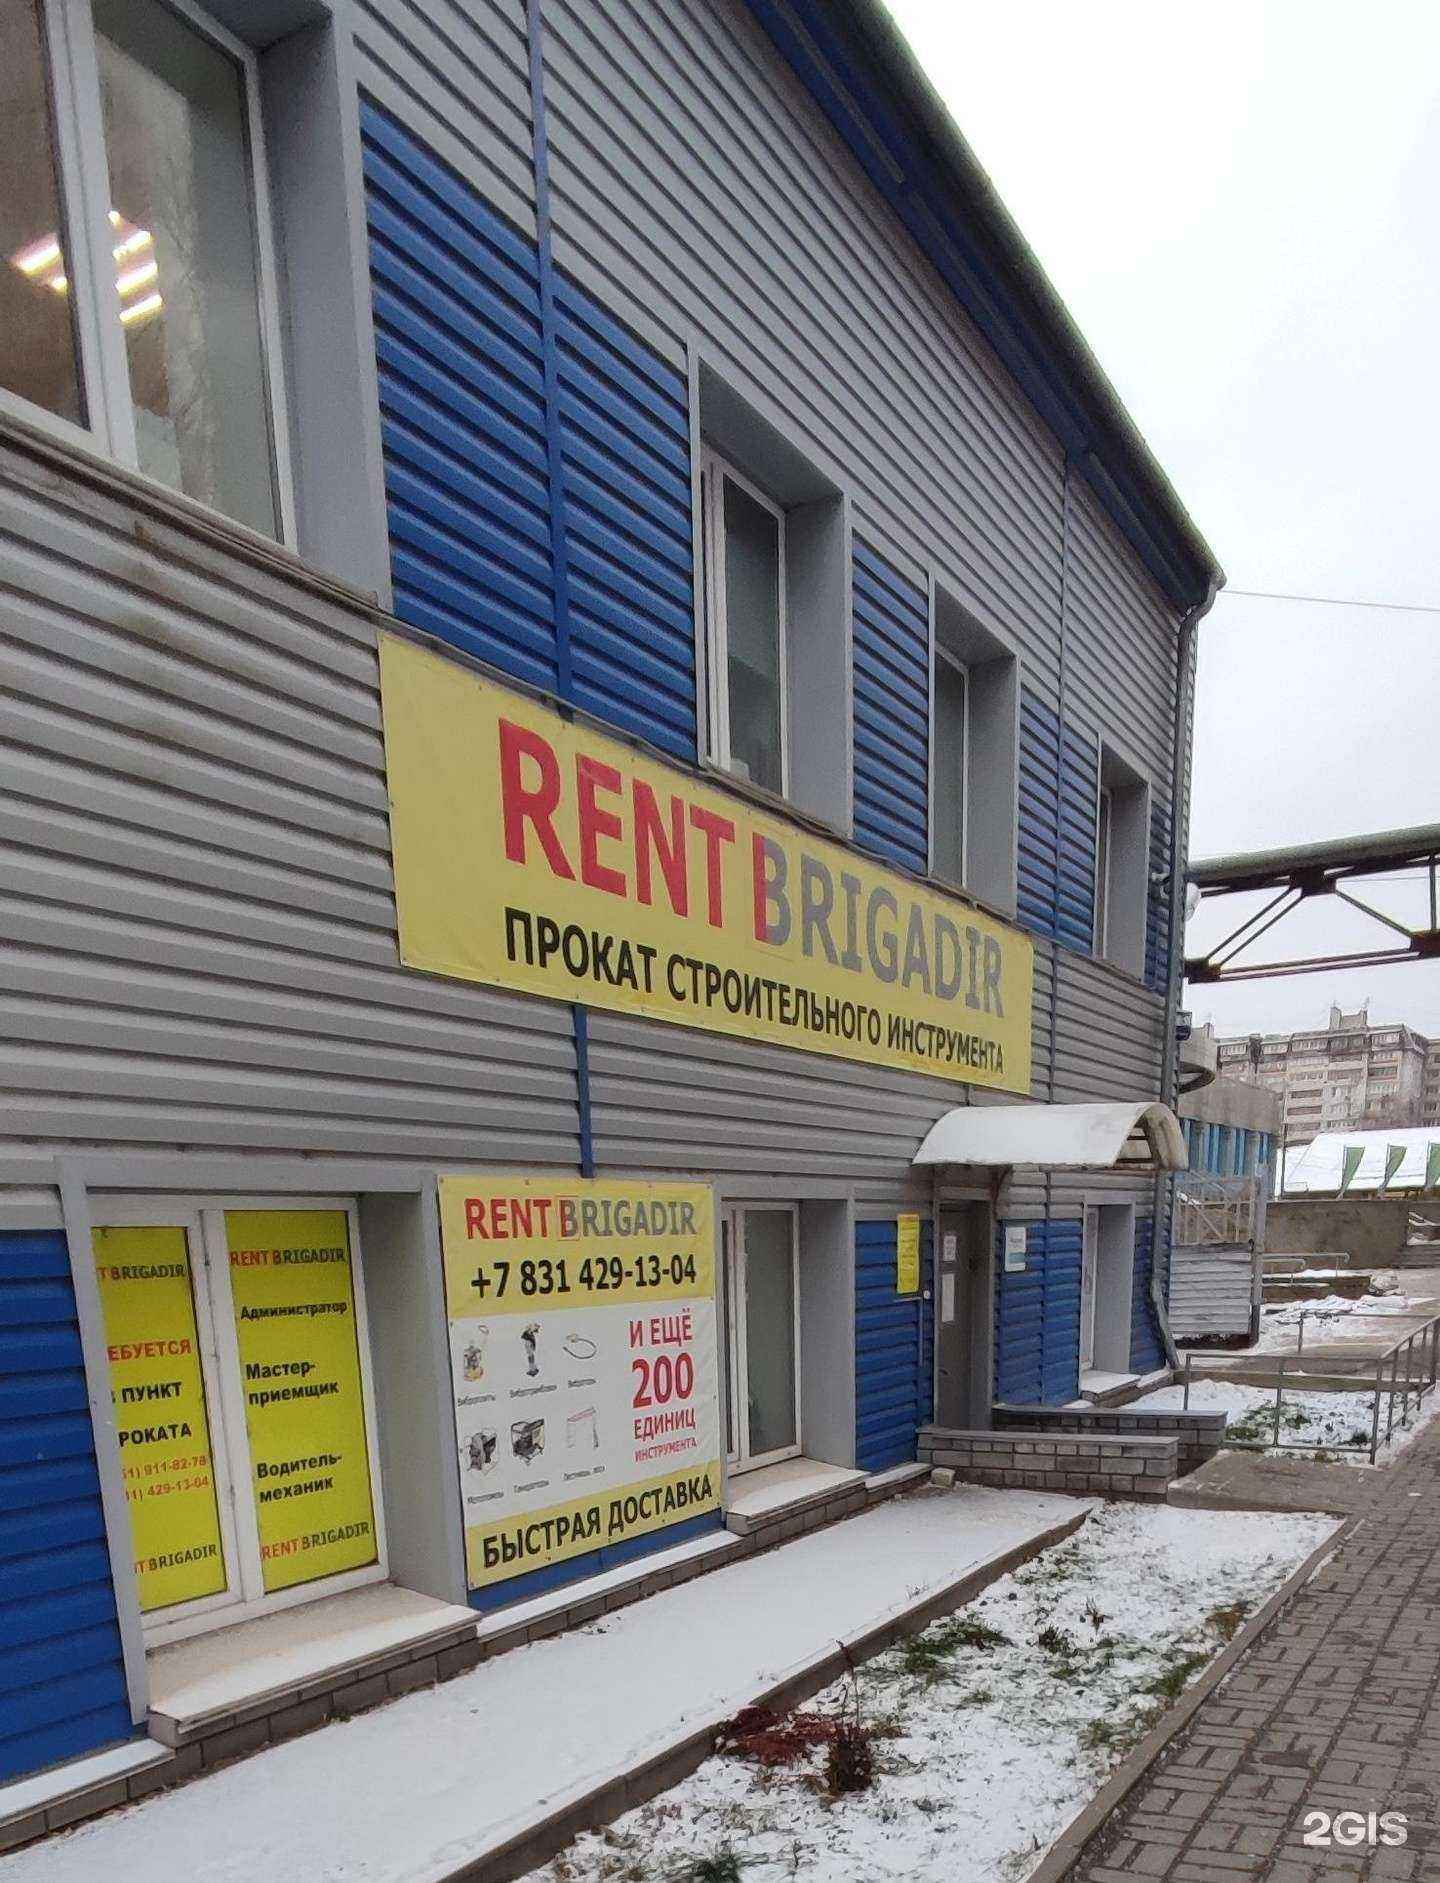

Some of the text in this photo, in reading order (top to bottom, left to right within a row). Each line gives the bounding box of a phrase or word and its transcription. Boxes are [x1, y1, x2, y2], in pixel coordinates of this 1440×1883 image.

[500, 717, 1005, 1018] RENT BRIGADIR
[504, 907, 1004, 1075] ПРОКАТ СТРОИТЕЛЬНОГО ИНСТРУМЕНТА
[465, 1198, 697, 1239] RENT BRIGADIR
[229, 1251, 267, 1266] RENT
[471, 1253, 697, 1298] +7 831 429-13-04
[240, 1303, 347, 1320] Администратор
[629, 1308, 693, 1348] И ЕЩЁ
[245, 1361, 316, 1380] Мастер-
[632, 1353, 694, 1410] 200
[121, 1381, 182, 1403] ПУНКТ
[248, 1381, 339, 1408] приемщик
[634, 1408, 696, 1441] ЕДИНИЦ
[257, 1453, 342, 1479] Водитель-
[259, 1479, 333, 1503] механик
[483, 1475, 713, 1569] БЫСТРАЯ ДОСТАВКА
[261, 1521, 370, 1560] RENT BRIGADIR
[148, 1544, 217, 1571] BRIGADIR
